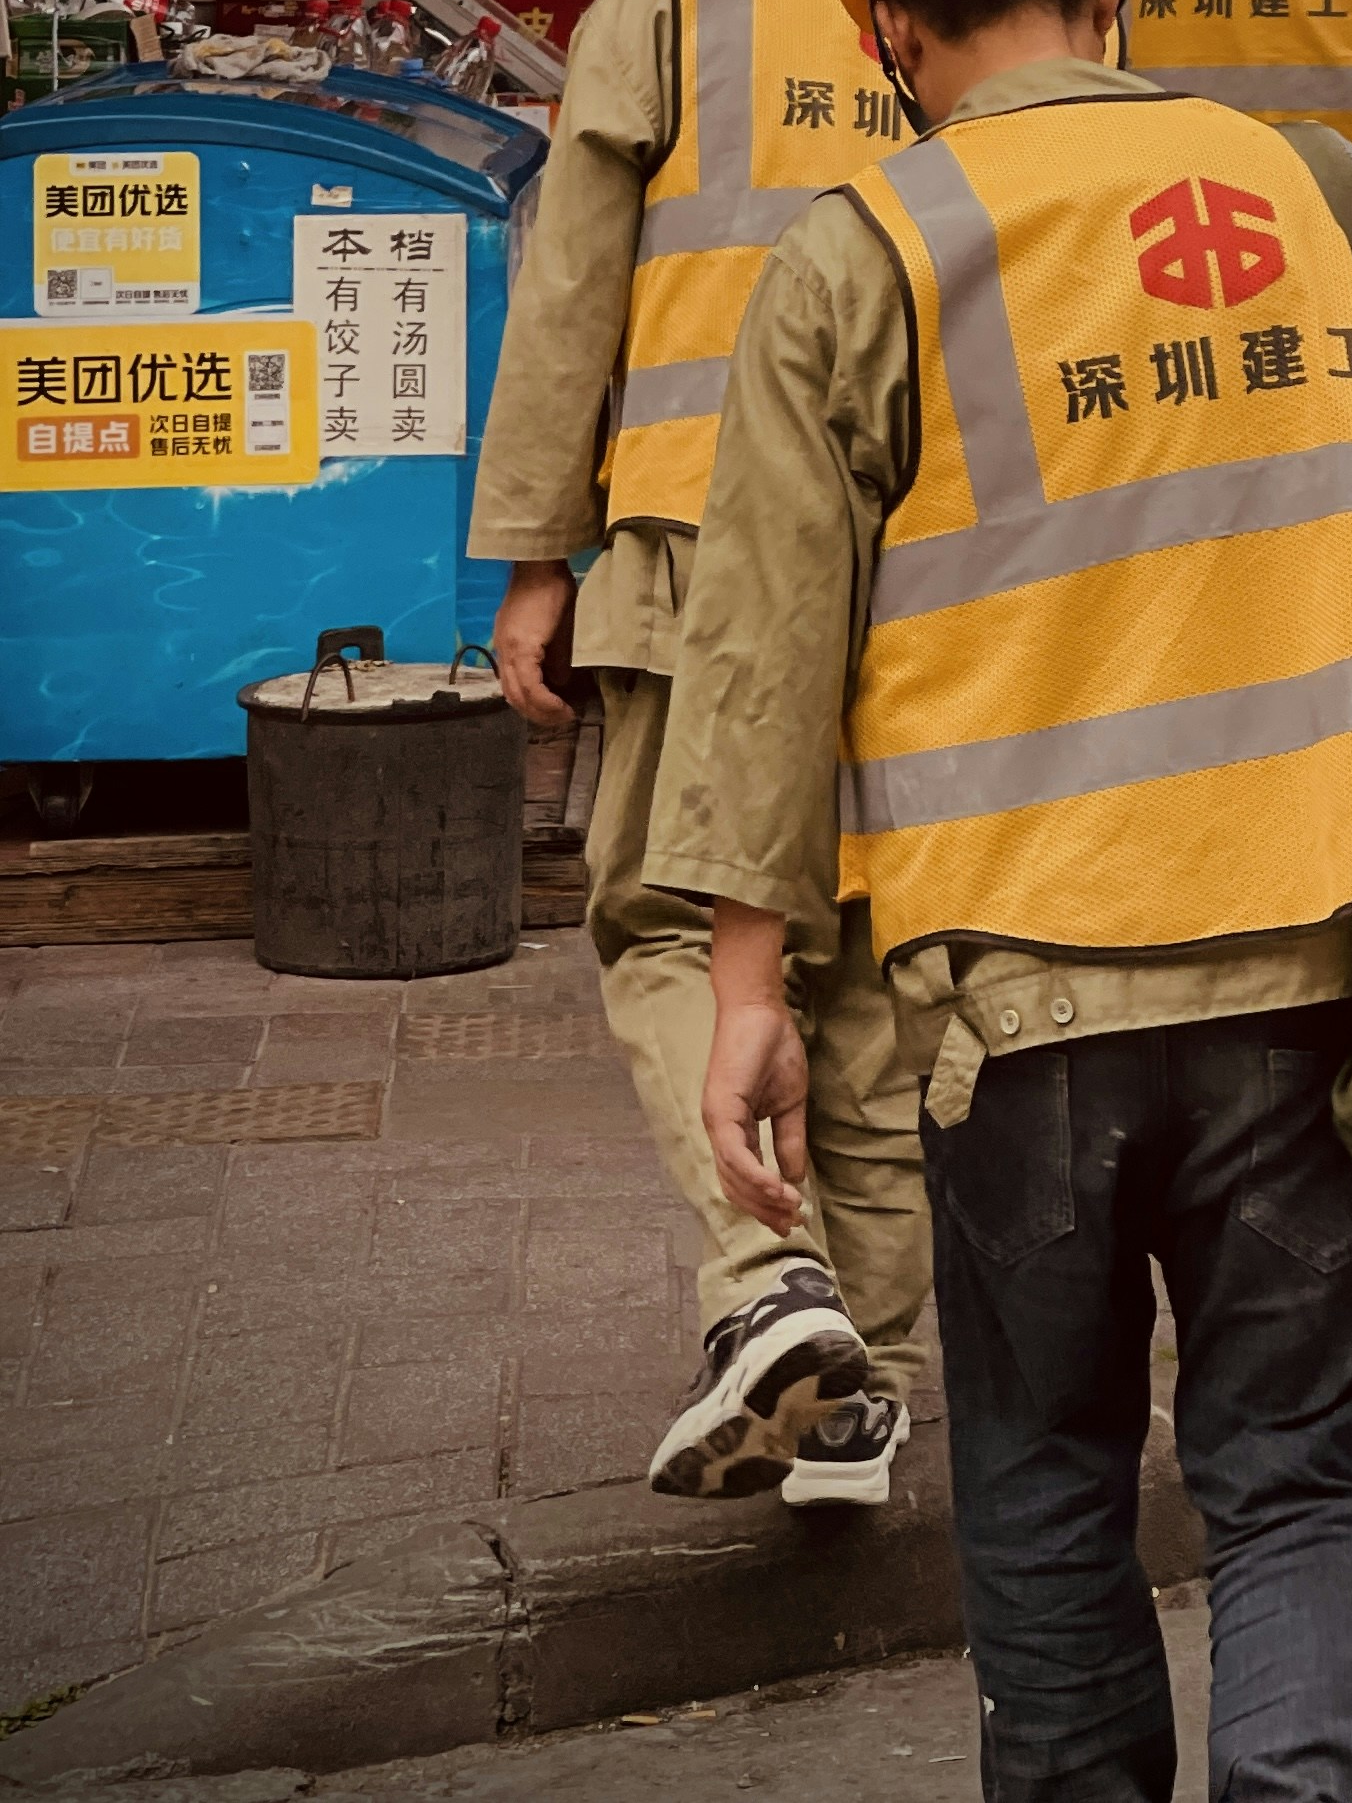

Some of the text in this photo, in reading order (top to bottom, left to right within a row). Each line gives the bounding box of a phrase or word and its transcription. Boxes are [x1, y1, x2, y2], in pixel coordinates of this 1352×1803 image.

[783, 77, 902, 141] 深圳
[46, 183, 188, 218] 美团优选
[51, 226, 183, 253] 便宜有好货
[322, 229, 435, 263] 本档
[324, 276, 361, 443] 有饺子卖
[391, 278, 428, 443] 有汤圆卖
[16, 352, 233, 407] 美团优选
[27, 423, 131, 455] 自提点
[150, 413, 233, 434] 次日自提
[150, 436, 233, 458] 售后无忧
